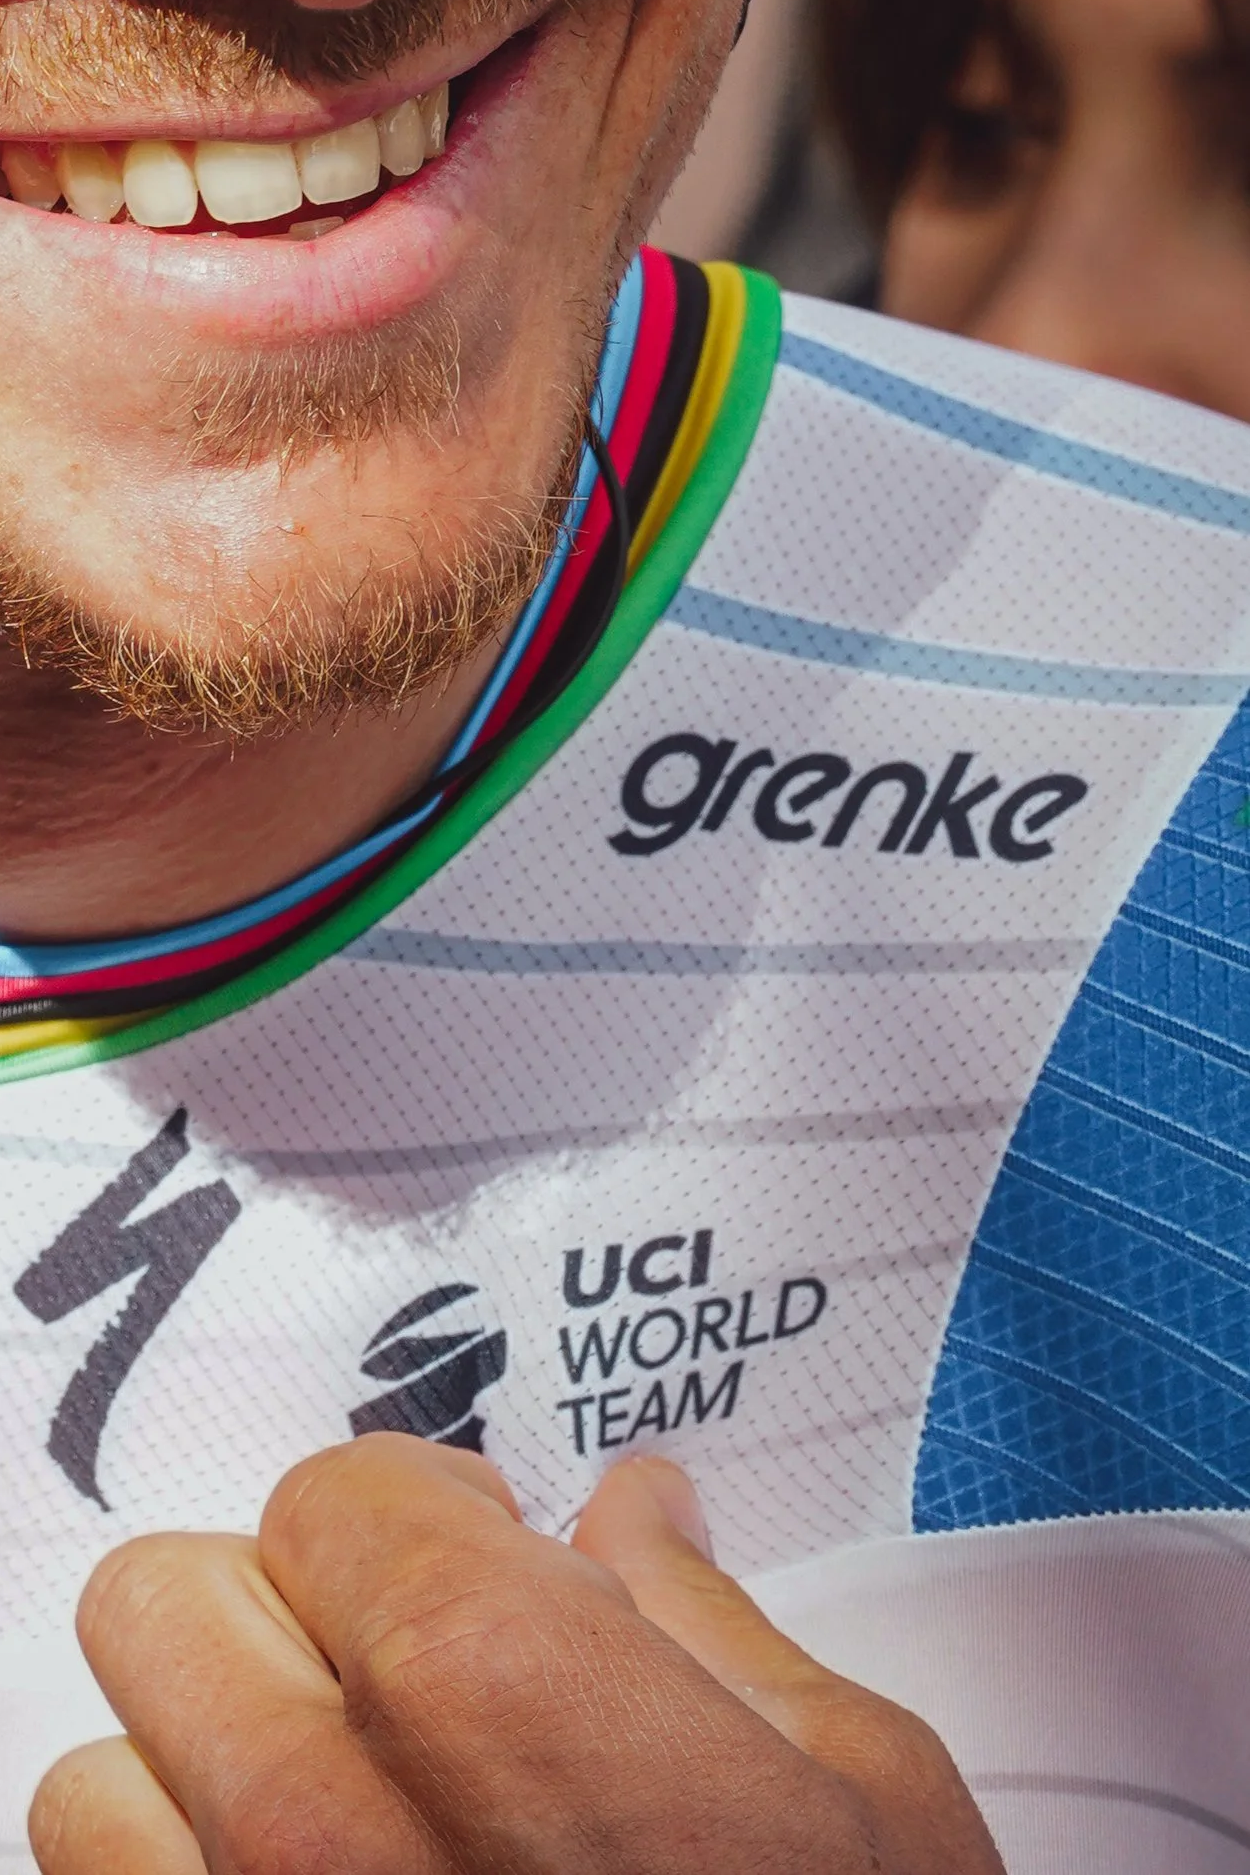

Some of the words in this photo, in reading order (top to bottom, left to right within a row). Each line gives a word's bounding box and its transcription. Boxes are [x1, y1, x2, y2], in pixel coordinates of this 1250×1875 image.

[607, 731, 1090, 863] grenke
[562, 1229, 713, 1308] UCI
[559, 1277, 828, 1385] WORLD
[557, 1360, 745, 1457] TEAM
